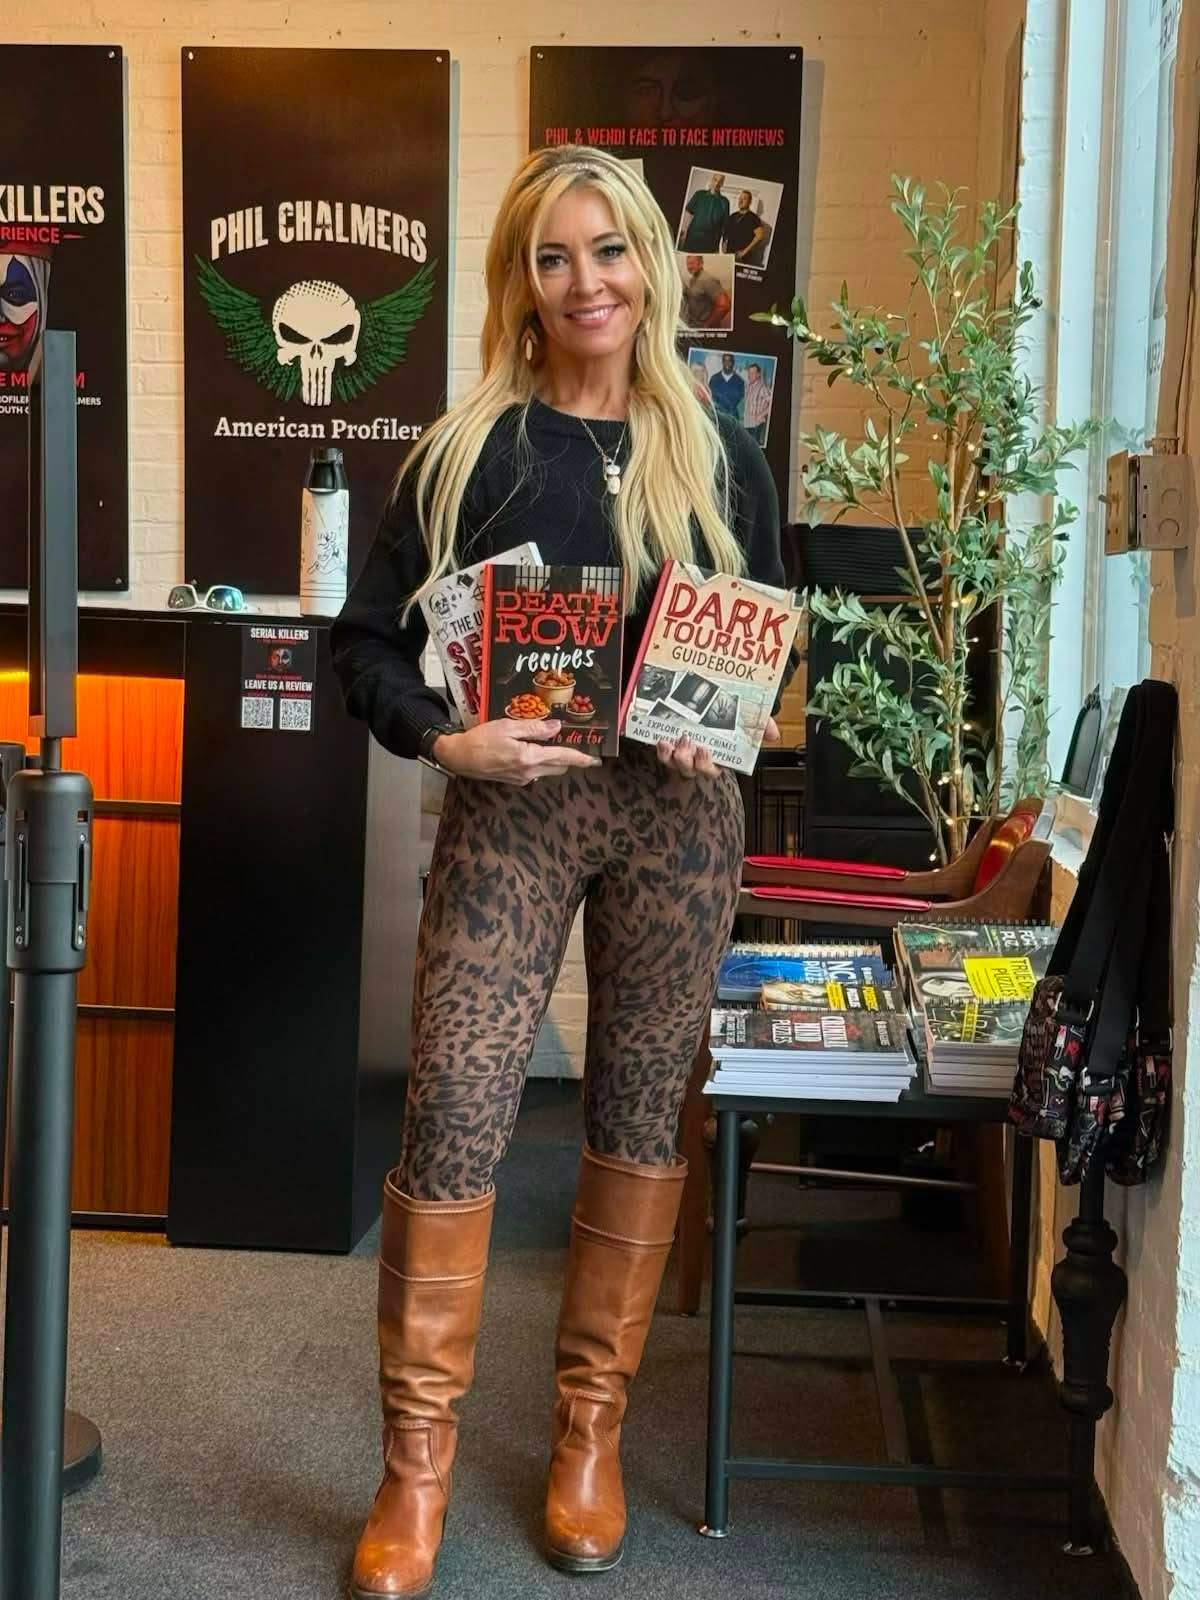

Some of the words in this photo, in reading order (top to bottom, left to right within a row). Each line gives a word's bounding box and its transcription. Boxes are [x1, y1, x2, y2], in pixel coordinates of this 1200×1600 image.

[545, 127, 570, 145] PHIL
[575, 128, 584, 145] &
[588, 127, 626, 146] WENDI
[630, 127, 658, 146] FACE
[663, 128, 677, 146] TO
[680, 127, 709, 147] FACE
[712, 127, 785, 147] INTERVIEWS
[211, 205, 269, 262] PHIL
[278, 200, 428, 264] CHALMERS
[214, 416, 326, 440] American
[331, 418, 422, 441] Profiler
[495, 590, 618, 615] DEATH
[666, 583, 790, 648] DARK
[250, 628, 278, 639] SERIAL
[279, 629, 309, 640] KILLERS
[450, 615, 474, 637] THE
[495, 612, 618, 648] ROW
[663, 616, 781, 670] TOURISM
[515, 645, 596, 678] recipes
[672, 645, 758, 682] GUIDEBOOK
[244, 680, 267, 690] LEAVE
[268, 681, 278, 690] US
[279, 681, 285, 691] A
[286, 682, 313, 692] REVIEW
[632, 727, 651, 739] AND
[709, 748, 743, 765] PPENED
[647, 719, 681, 736] EXPLORE
[708, 736, 738, 753] CRIMES
[990, 967, 1019, 997] PUZZLES
[1010, 959, 1033, 980] TRUE
[771, 1019, 793, 1045] PUZZLES
[794, 1022, 822, 1042] MIND
[821, 1016, 849, 1048] CRIMINAL
